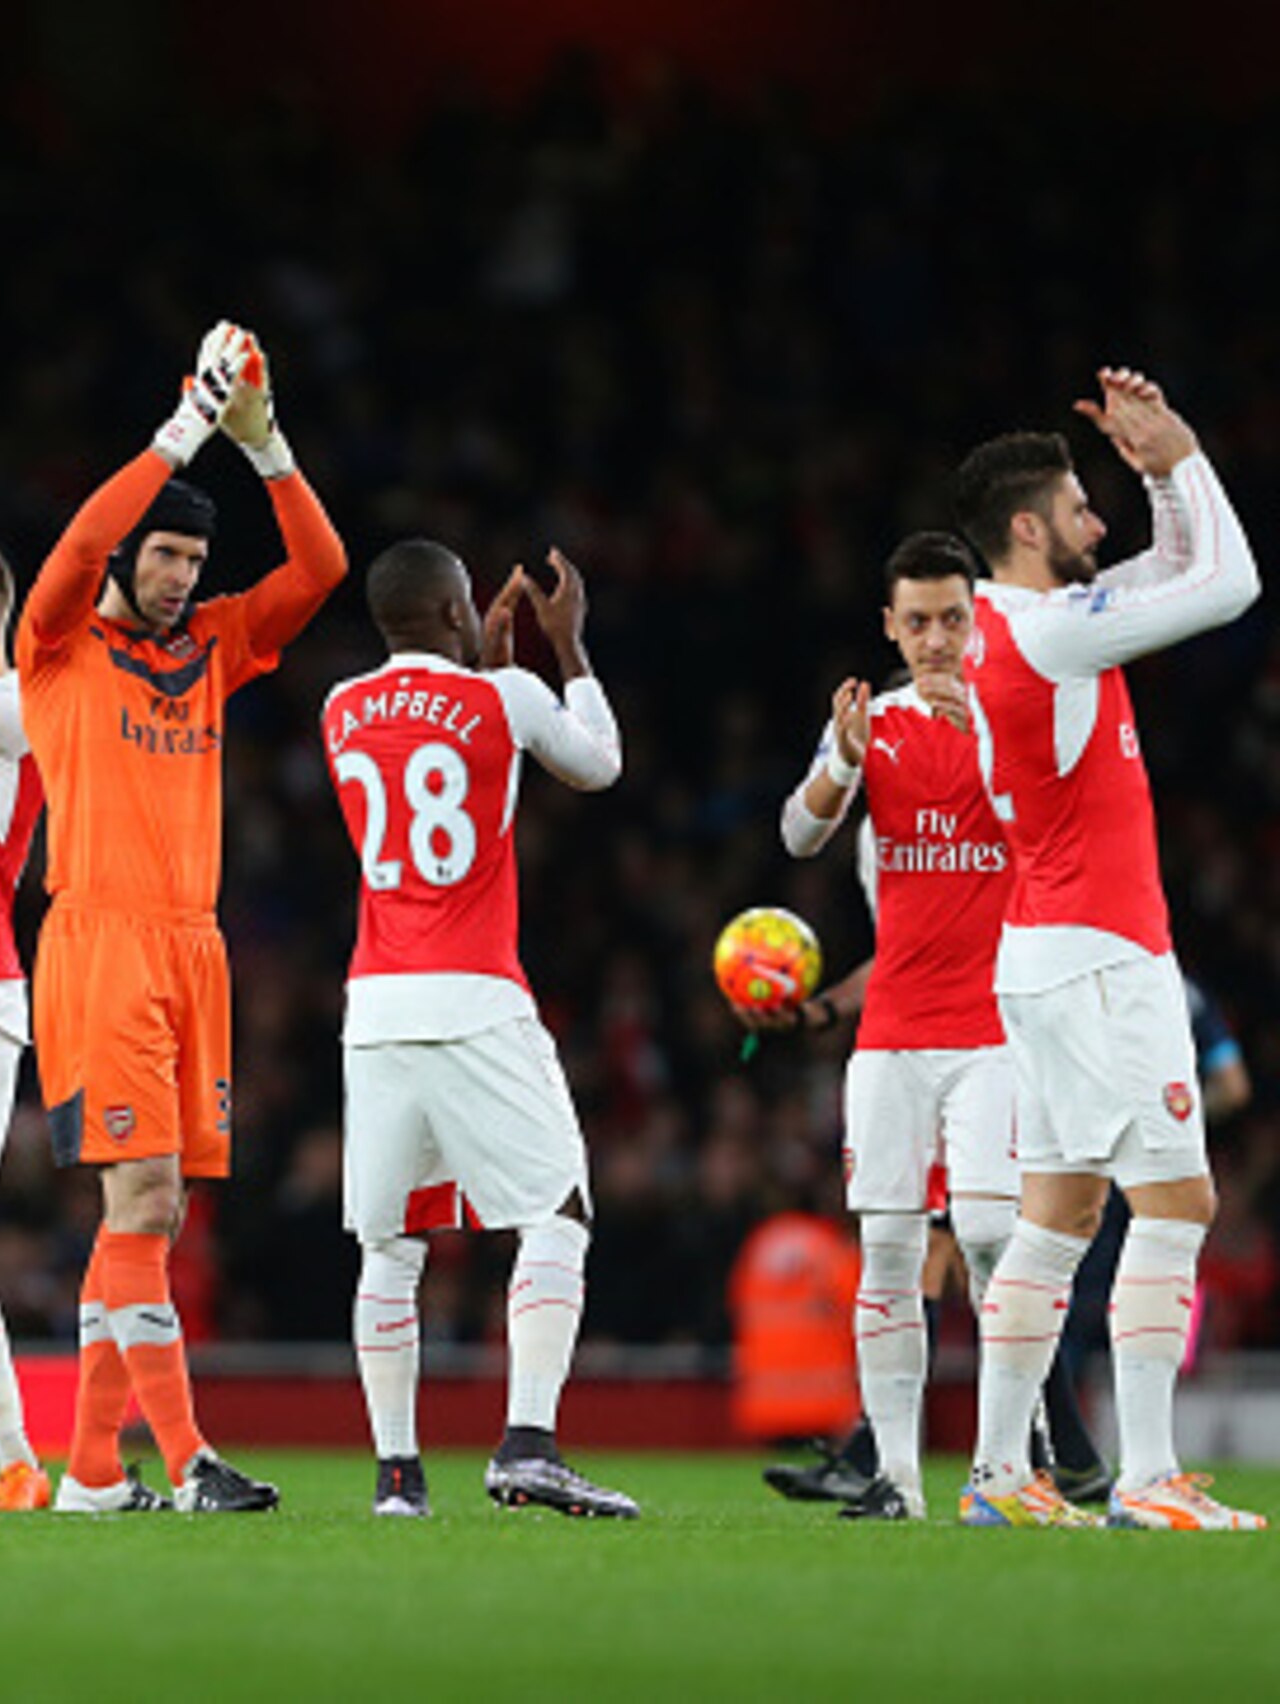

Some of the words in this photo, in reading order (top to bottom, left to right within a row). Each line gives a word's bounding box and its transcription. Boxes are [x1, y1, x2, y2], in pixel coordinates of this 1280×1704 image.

[329, 691, 482, 754] CAMPBELL
[334, 743, 477, 891] 28
[916, 809, 958, 839] Fly
[876, 836, 1008, 872] Emirates
